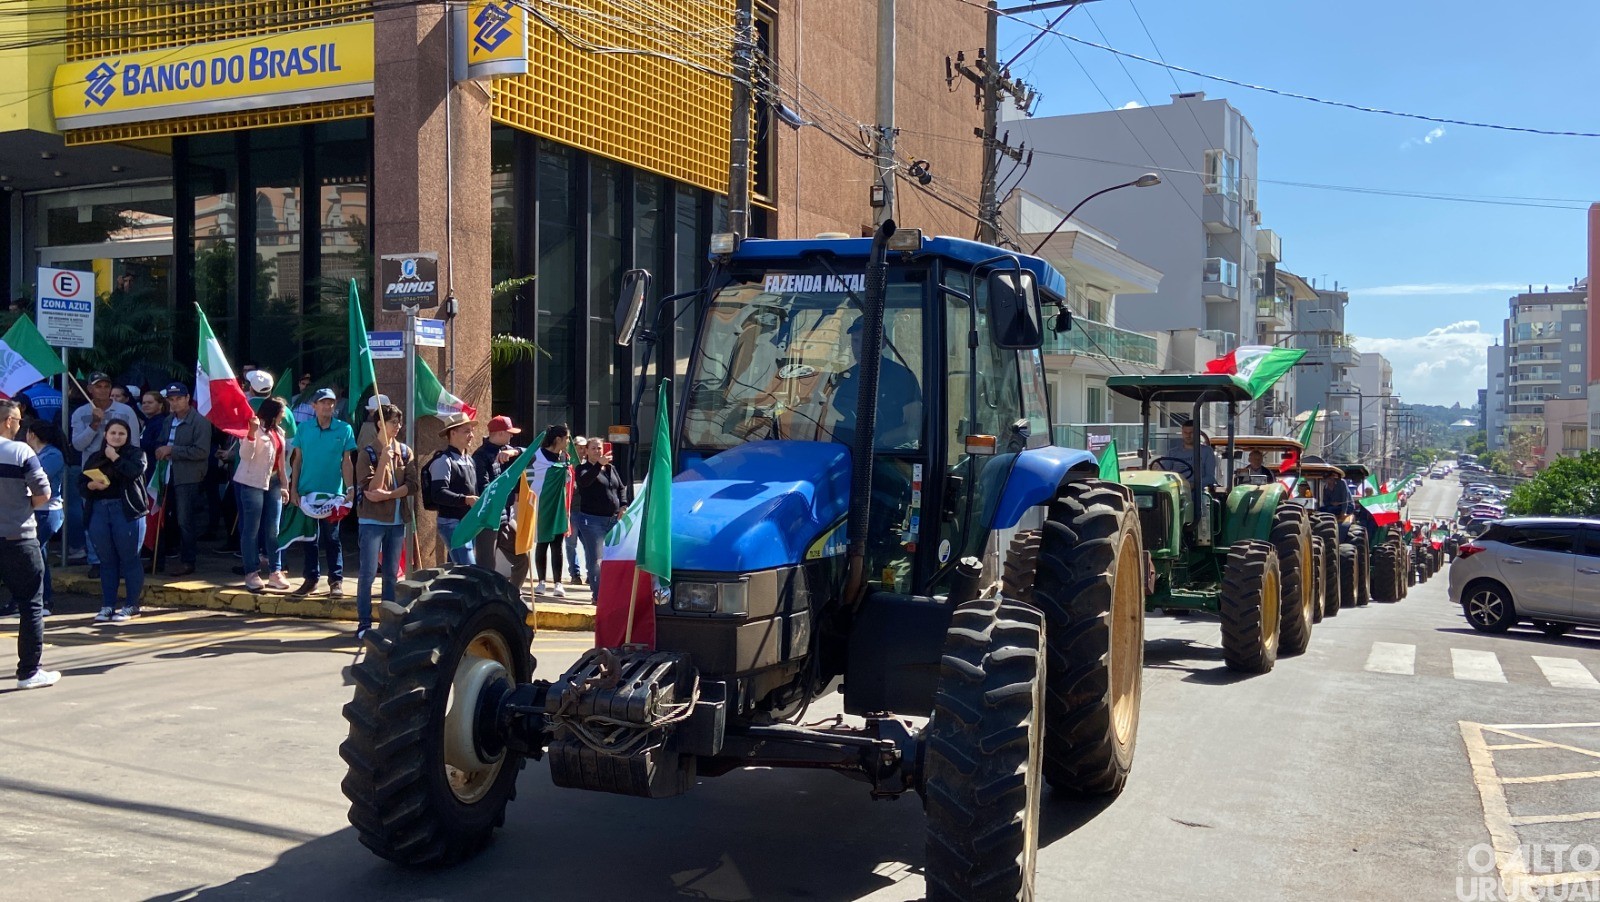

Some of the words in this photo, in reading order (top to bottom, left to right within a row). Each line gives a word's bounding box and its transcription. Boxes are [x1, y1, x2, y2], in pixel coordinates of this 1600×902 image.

[123, 59, 206, 96] BANCO
[211, 55, 244, 85] DO
[250, 43, 341, 81] BRASIL
[61, 277, 72, 291] E
[386, 281, 435, 294] PRIMUS
[764, 274, 822, 293] FAZENDA
[43, 300, 67, 309] ZONA
[69, 302, 90, 311] AZUL
